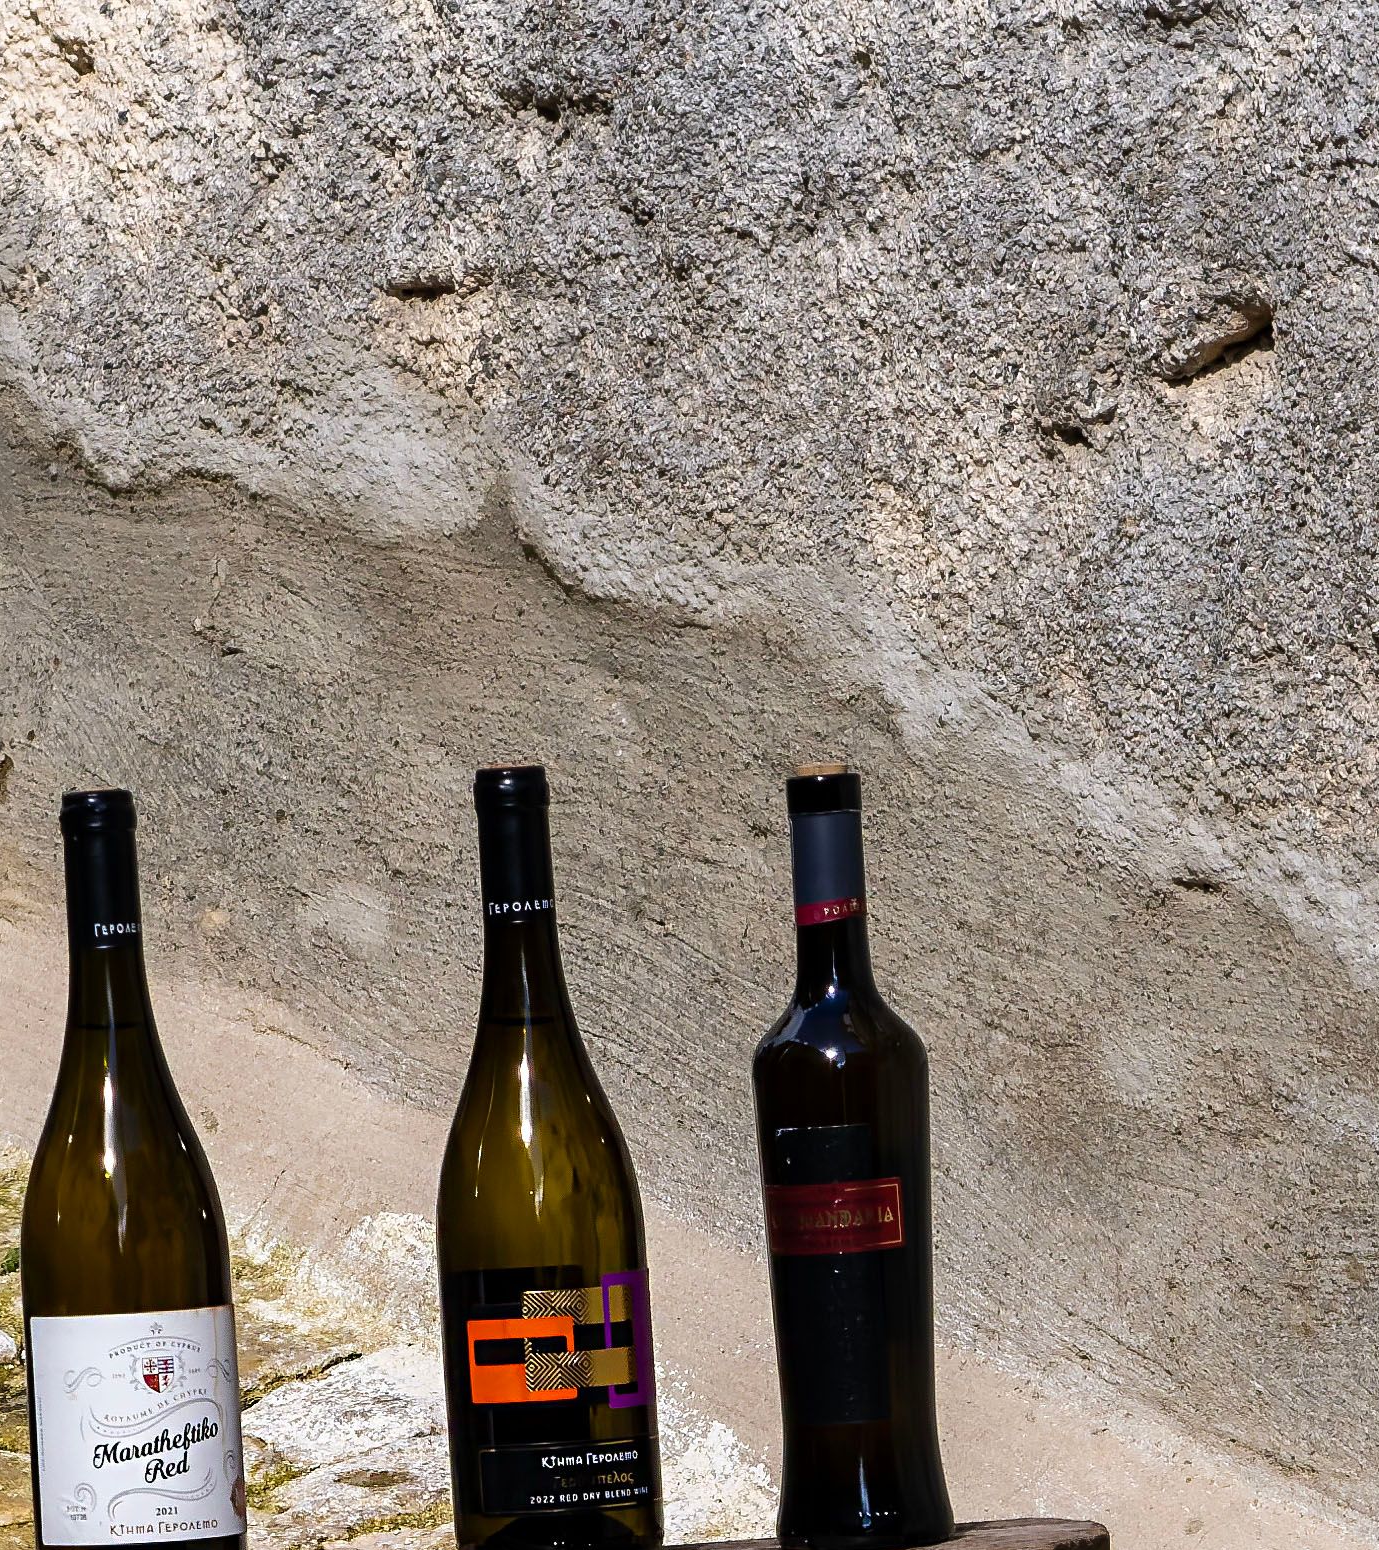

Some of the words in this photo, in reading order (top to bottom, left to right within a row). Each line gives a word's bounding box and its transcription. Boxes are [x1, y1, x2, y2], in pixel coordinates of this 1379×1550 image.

[109, 1341, 151, 1359] PRODUCT
[155, 1340, 167, 1348] OF
[171, 1340, 202, 1353] CYPRUS
[103, 1406, 153, 1423] ROYAUME
[157, 1400, 171, 1411] DE
[93, 1416, 219, 1469] Maratheftiko
[144, 1450, 190, 1483] Red
[529, 1495, 555, 1505] 2022
[559, 1493, 579, 1503] RED
[583, 1491, 600, 1501] DRY
[604, 1487, 632, 1499] BLEND
[155, 1506, 178, 1516] 2021
